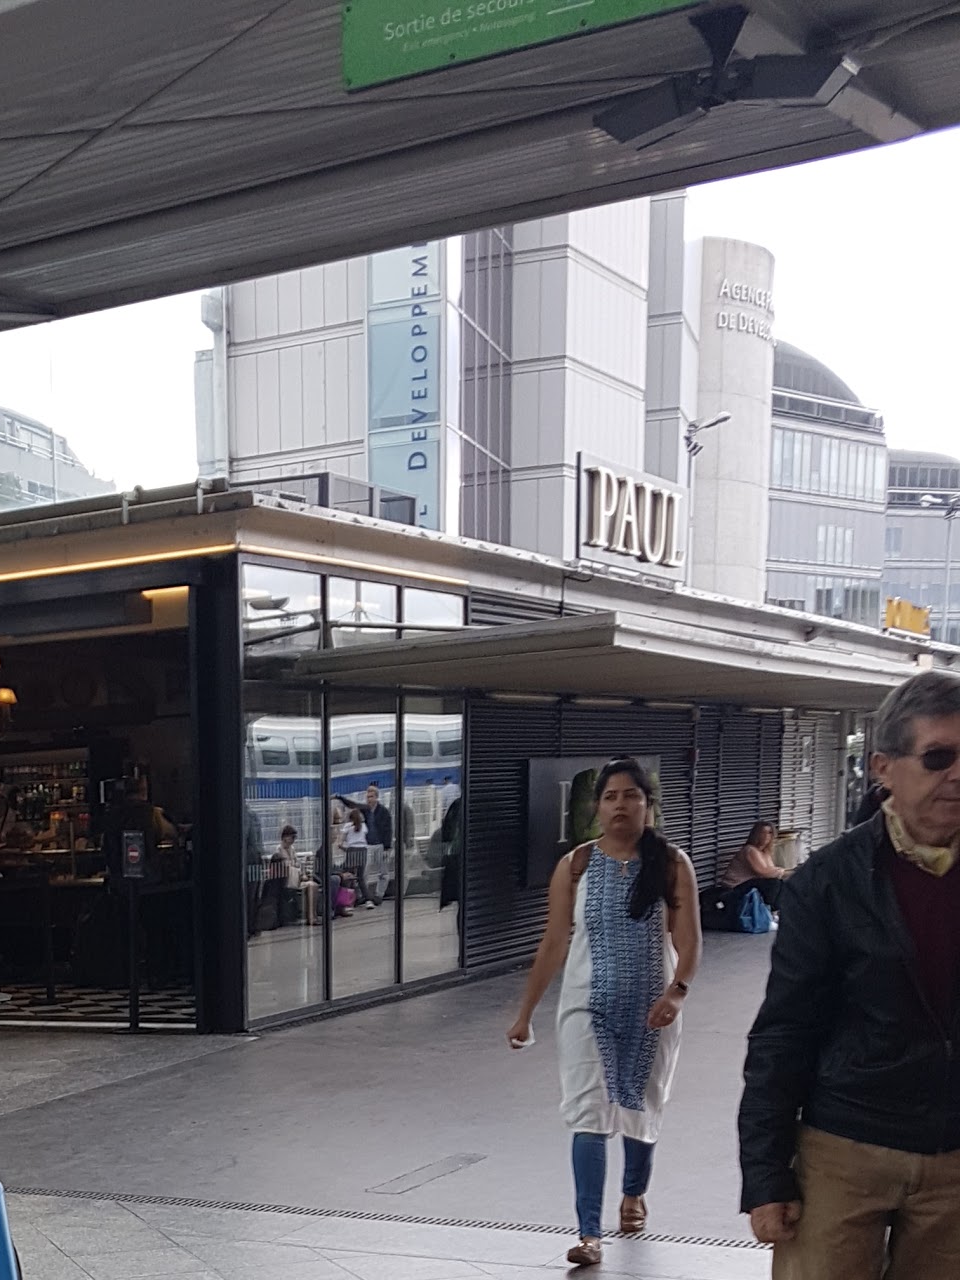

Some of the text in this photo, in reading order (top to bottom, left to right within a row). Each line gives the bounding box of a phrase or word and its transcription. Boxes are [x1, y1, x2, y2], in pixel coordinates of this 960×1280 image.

[384, 0, 535, 41] Sortie de secou
[717, 311, 737, 330] DE
[585, 466, 686, 567] PAUL
